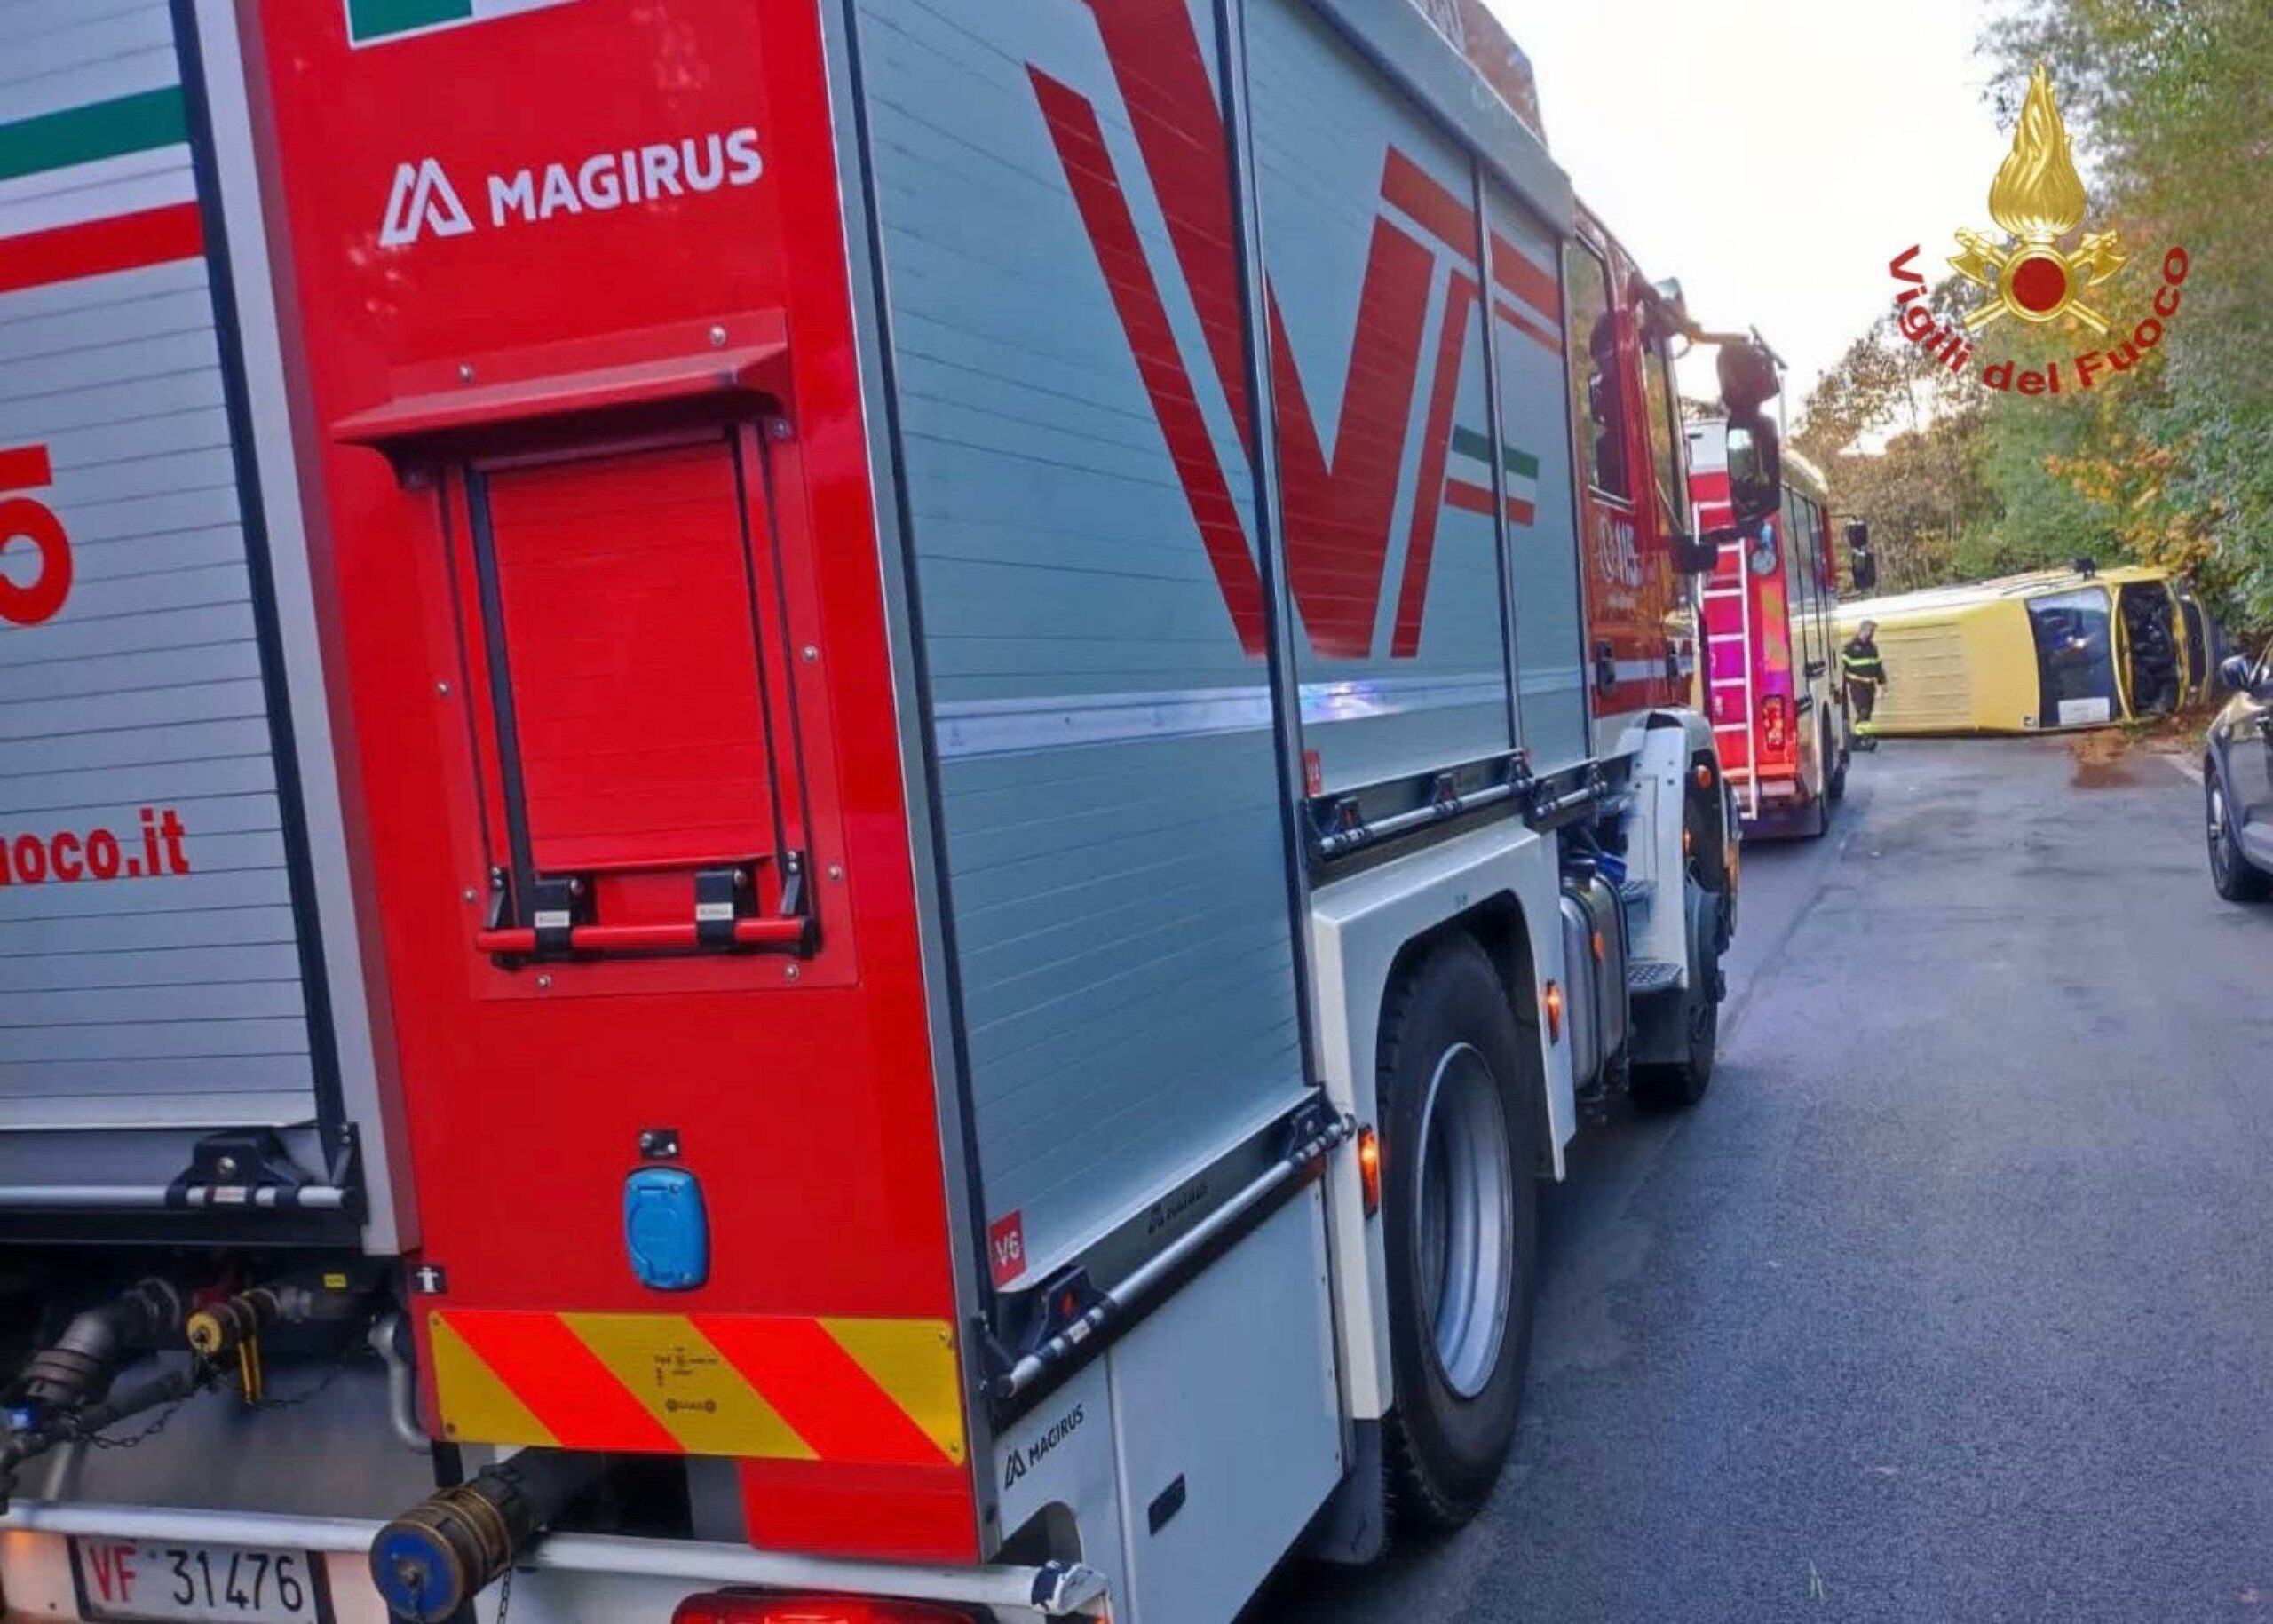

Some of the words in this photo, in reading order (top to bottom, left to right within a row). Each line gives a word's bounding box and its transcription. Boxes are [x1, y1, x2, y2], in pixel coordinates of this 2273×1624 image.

[487, 127, 763, 228] MAGIRUS
[995, 1230, 1020, 1267] V6
[1028, 1403, 1084, 1468] MAGIRUS
[91, 1545, 137, 1602] VF
[166, 1549, 304, 1612] 31476
